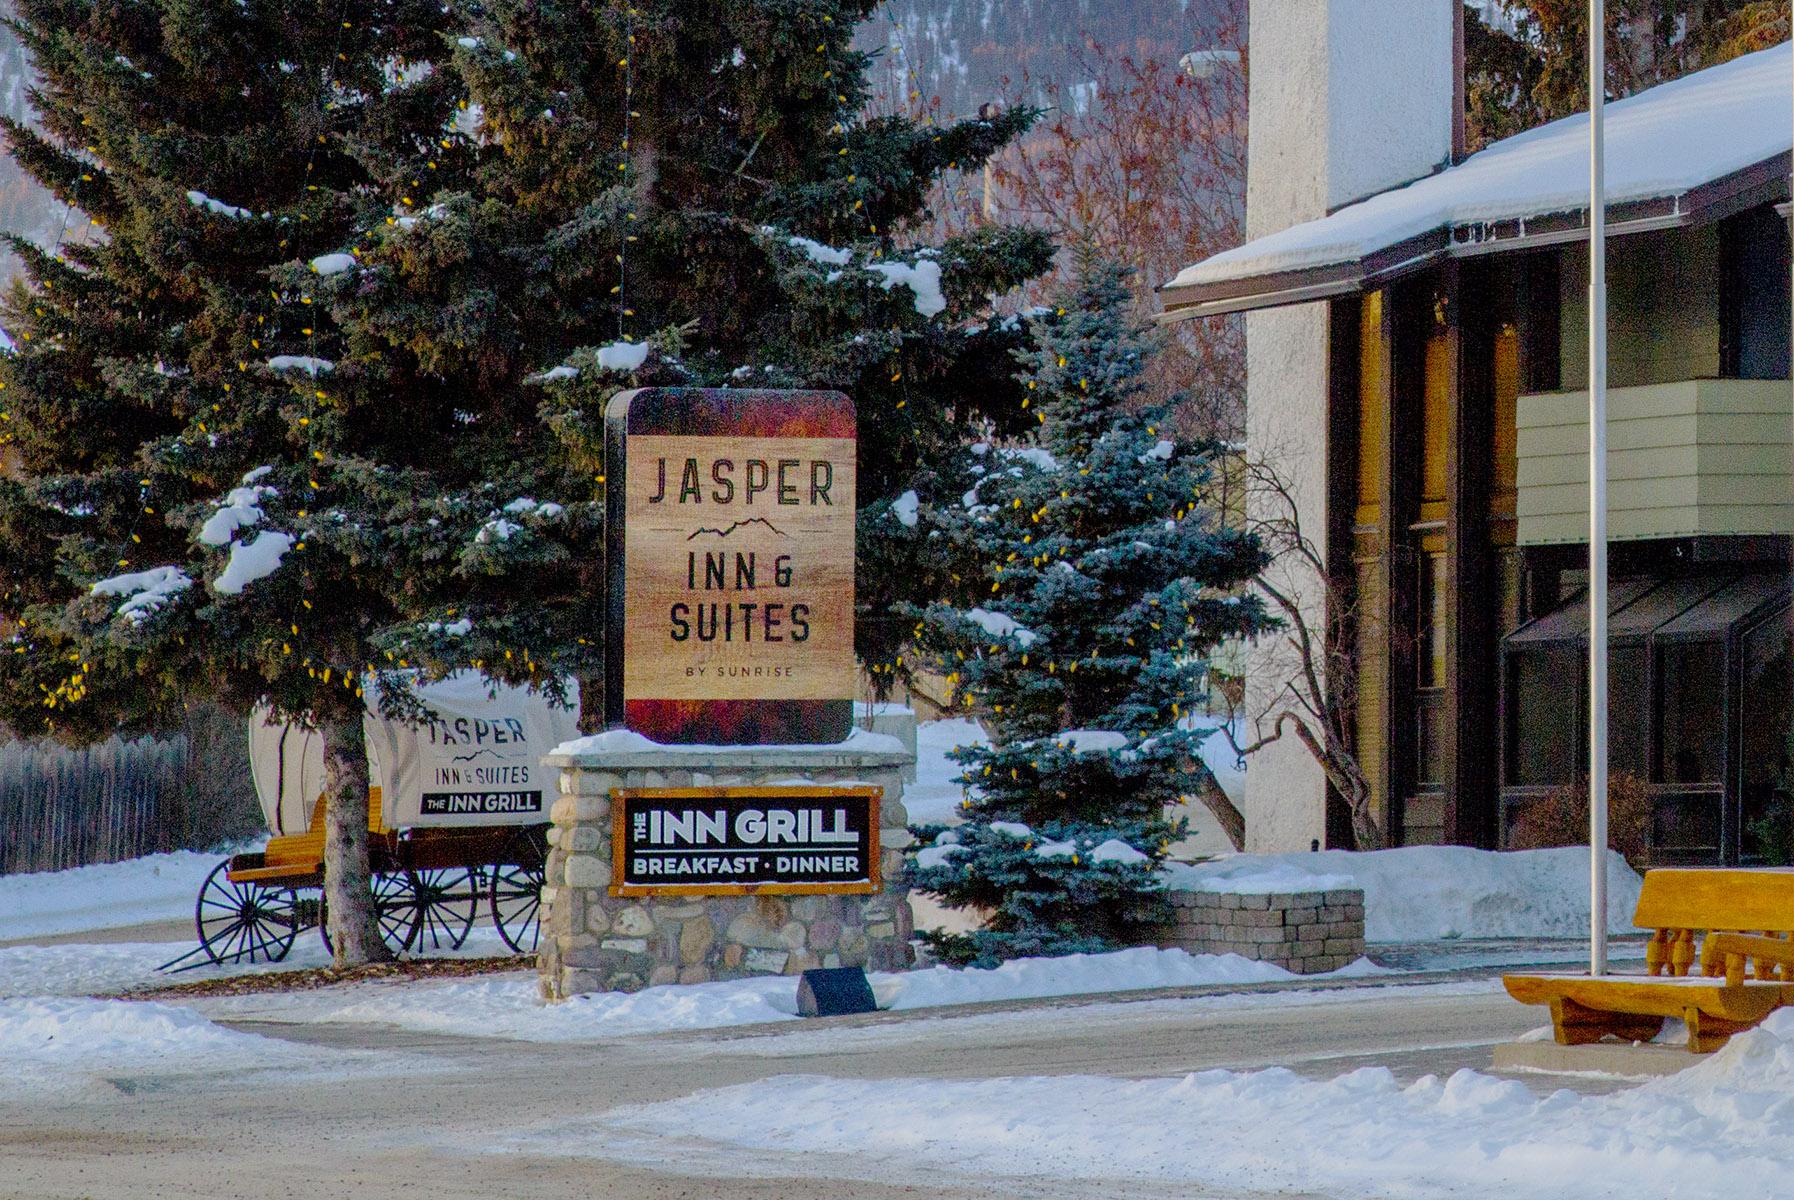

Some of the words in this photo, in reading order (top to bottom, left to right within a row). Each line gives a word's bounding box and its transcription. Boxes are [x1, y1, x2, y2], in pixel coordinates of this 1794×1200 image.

[649, 457, 833, 506] JASPER
[687, 551, 755, 591] INN
[774, 555, 793, 587] &
[670, 603, 810, 642] SUITES
[686, 667, 706, 677] BY
[717, 667, 793, 677] SUNRISE
[435, 768, 460, 785] INN
[475, 766, 529, 785] SUITES
[427, 799, 446, 809] THE
[448, 794, 481, 812] INN
[485, 793, 537, 812] GRILL
[634, 811, 647, 842] THE
[650, 810, 727, 844] INN
[734, 809, 859, 844] GRILL
[633, 857, 758, 875] BREAKFAST
[776, 856, 859, 873] DINNER
